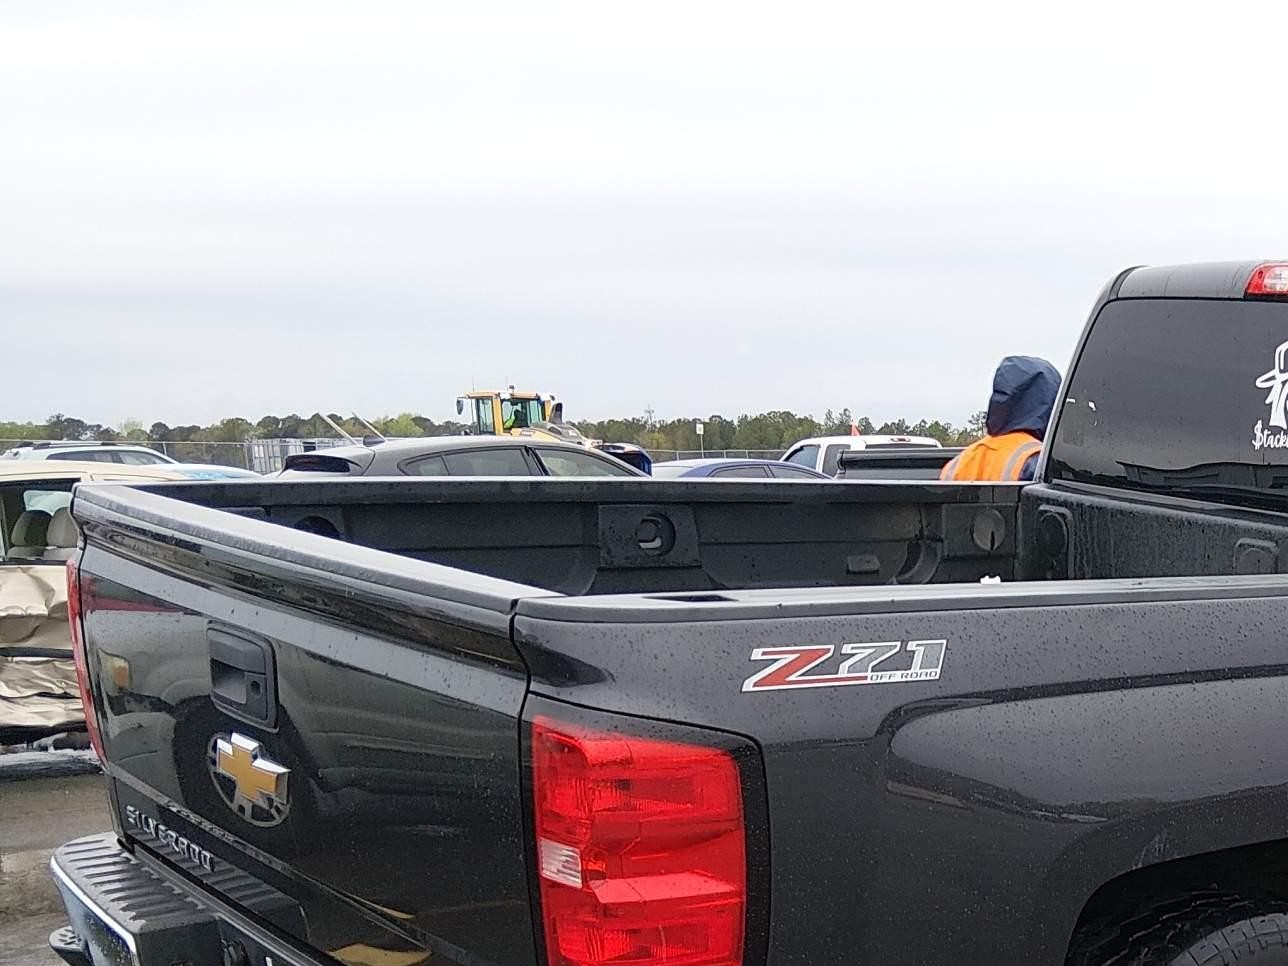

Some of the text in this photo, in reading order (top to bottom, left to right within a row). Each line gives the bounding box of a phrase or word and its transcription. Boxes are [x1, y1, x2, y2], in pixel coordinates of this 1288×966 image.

[741, 639, 948, 692] Z71
[869, 669, 938, 682] OFF ROAD
[126, 804, 215, 873] SILVERADO
